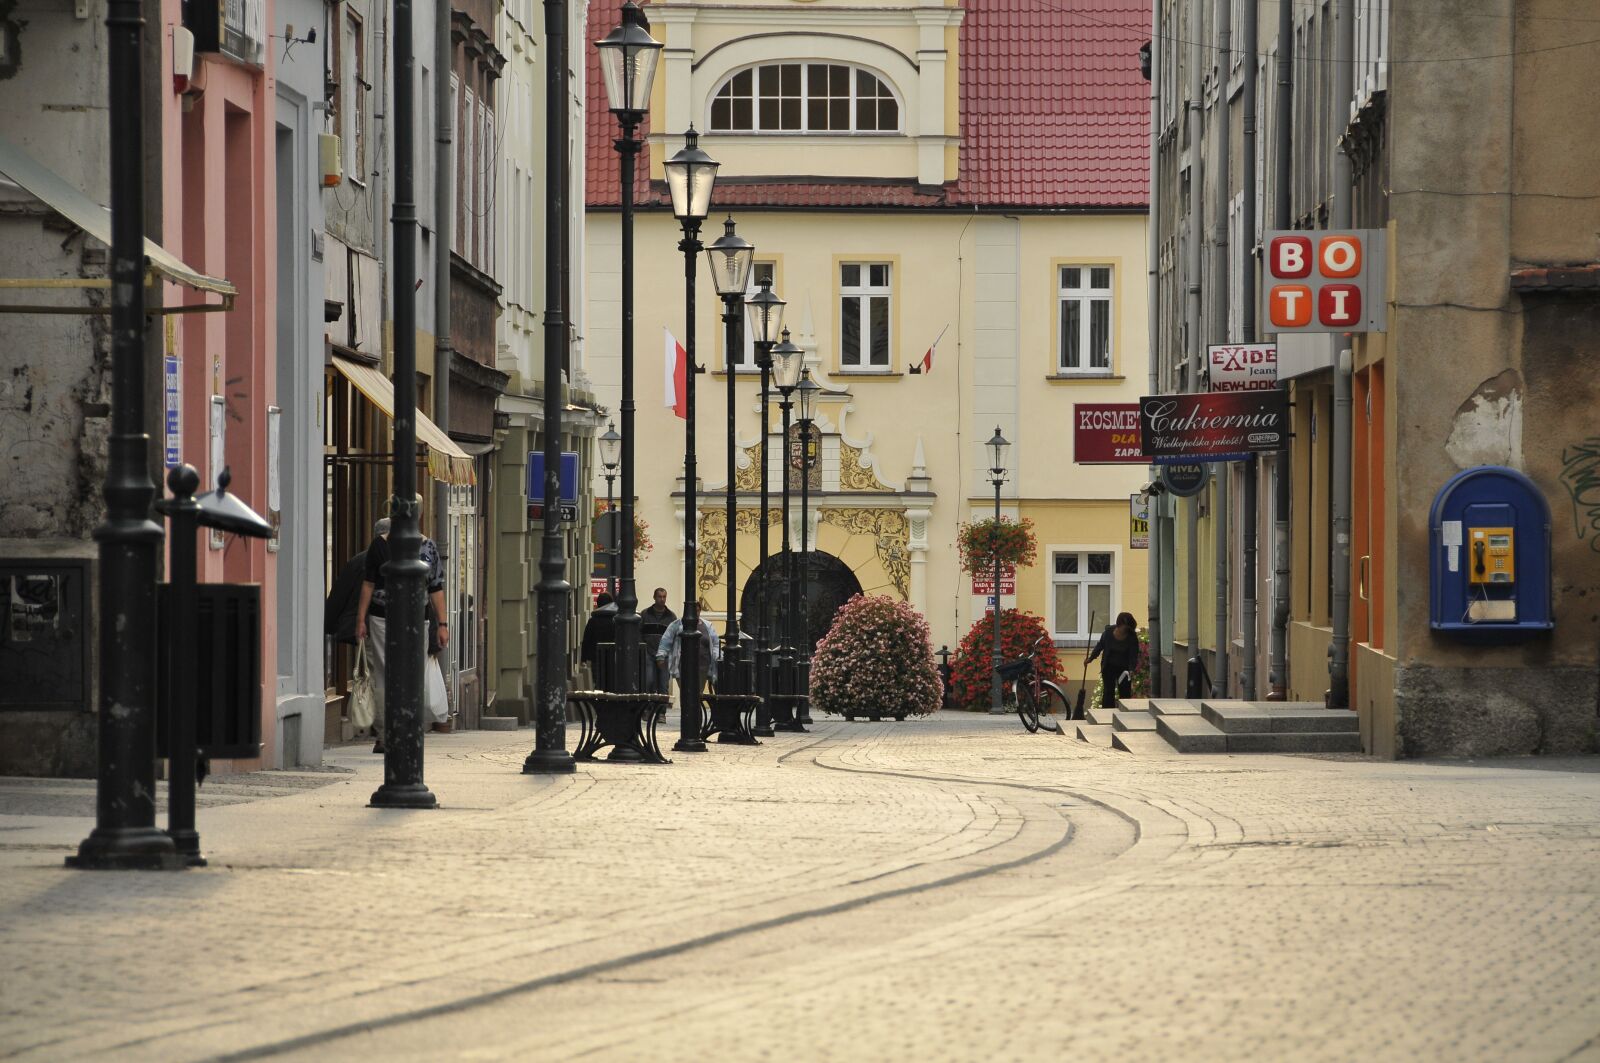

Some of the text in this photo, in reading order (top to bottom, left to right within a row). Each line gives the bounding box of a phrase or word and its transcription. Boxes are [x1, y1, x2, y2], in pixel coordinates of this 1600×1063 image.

[1212, 346, 1277, 371] EXIDE
[1249, 366, 1277, 377] Jeans
[1144, 400, 1279, 436] Cukiernia
[1111, 433, 1136, 444] DLA
[1151, 434, 1210, 451] Wielkopolska
[1169, 465, 1201, 473] NIVEA
